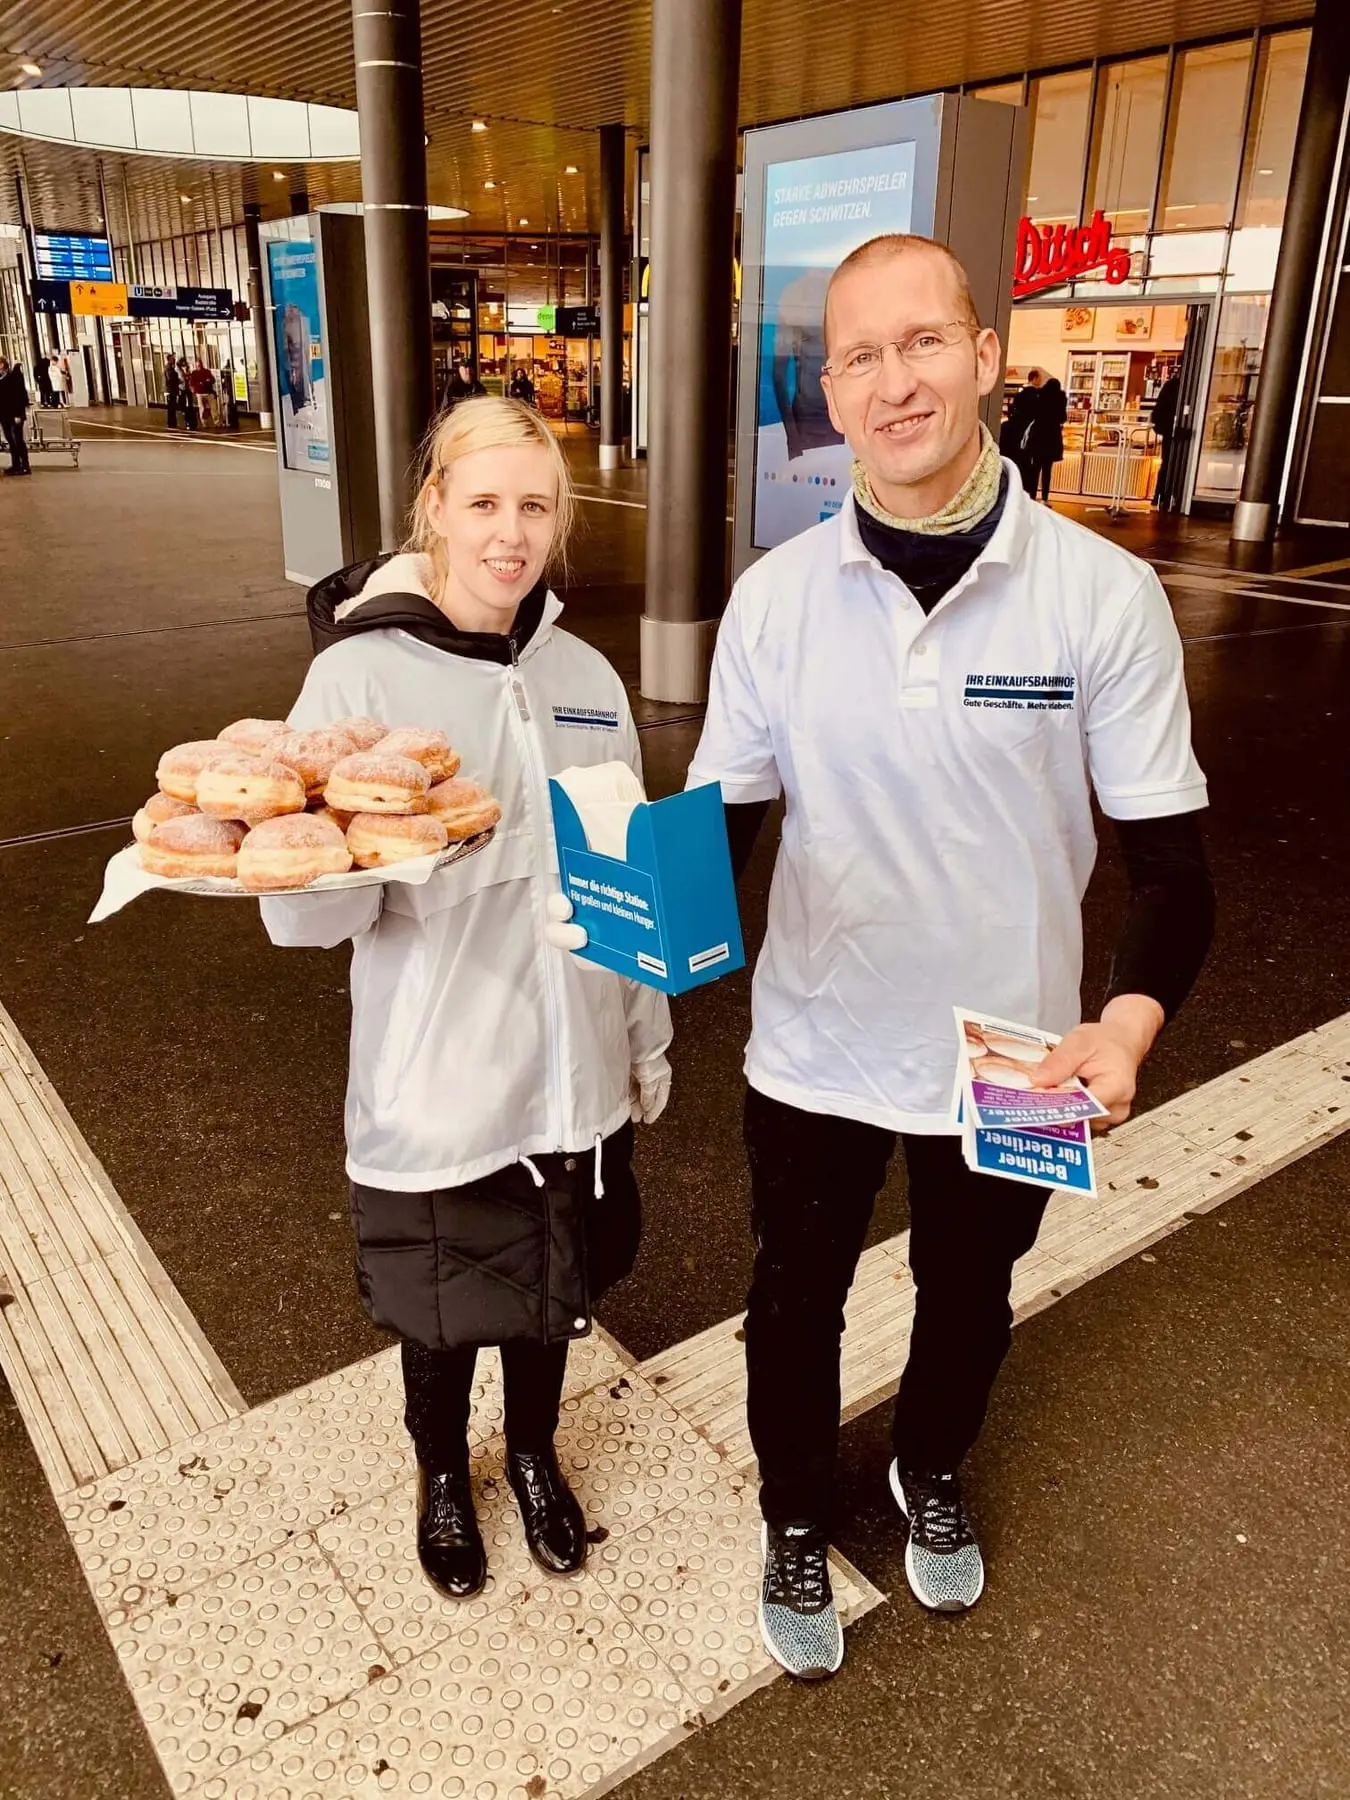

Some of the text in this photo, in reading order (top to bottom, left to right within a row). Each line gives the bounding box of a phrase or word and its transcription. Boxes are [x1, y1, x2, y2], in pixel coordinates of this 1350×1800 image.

[773, 208, 807, 228] GEGEN
[1012, 209, 1130, 292] Ditsch
[966, 674, 1075, 688] IHR EINKAUFSBAHNHOF
[963, 699, 982, 707] Gute
[983, 700, 1025, 709] Geschäfte.
[1027, 702, 1047, 710] Mehr
[568, 872, 589, 889] Immer
[589, 879, 600, 893] die
[570, 889, 581, 902] Für
[601, 901, 613, 913] und
[612, 903, 634, 921] kleinen
[980, 1130, 1082, 1166] für Berliner.
[998, 1151, 1068, 1181] Berliner
